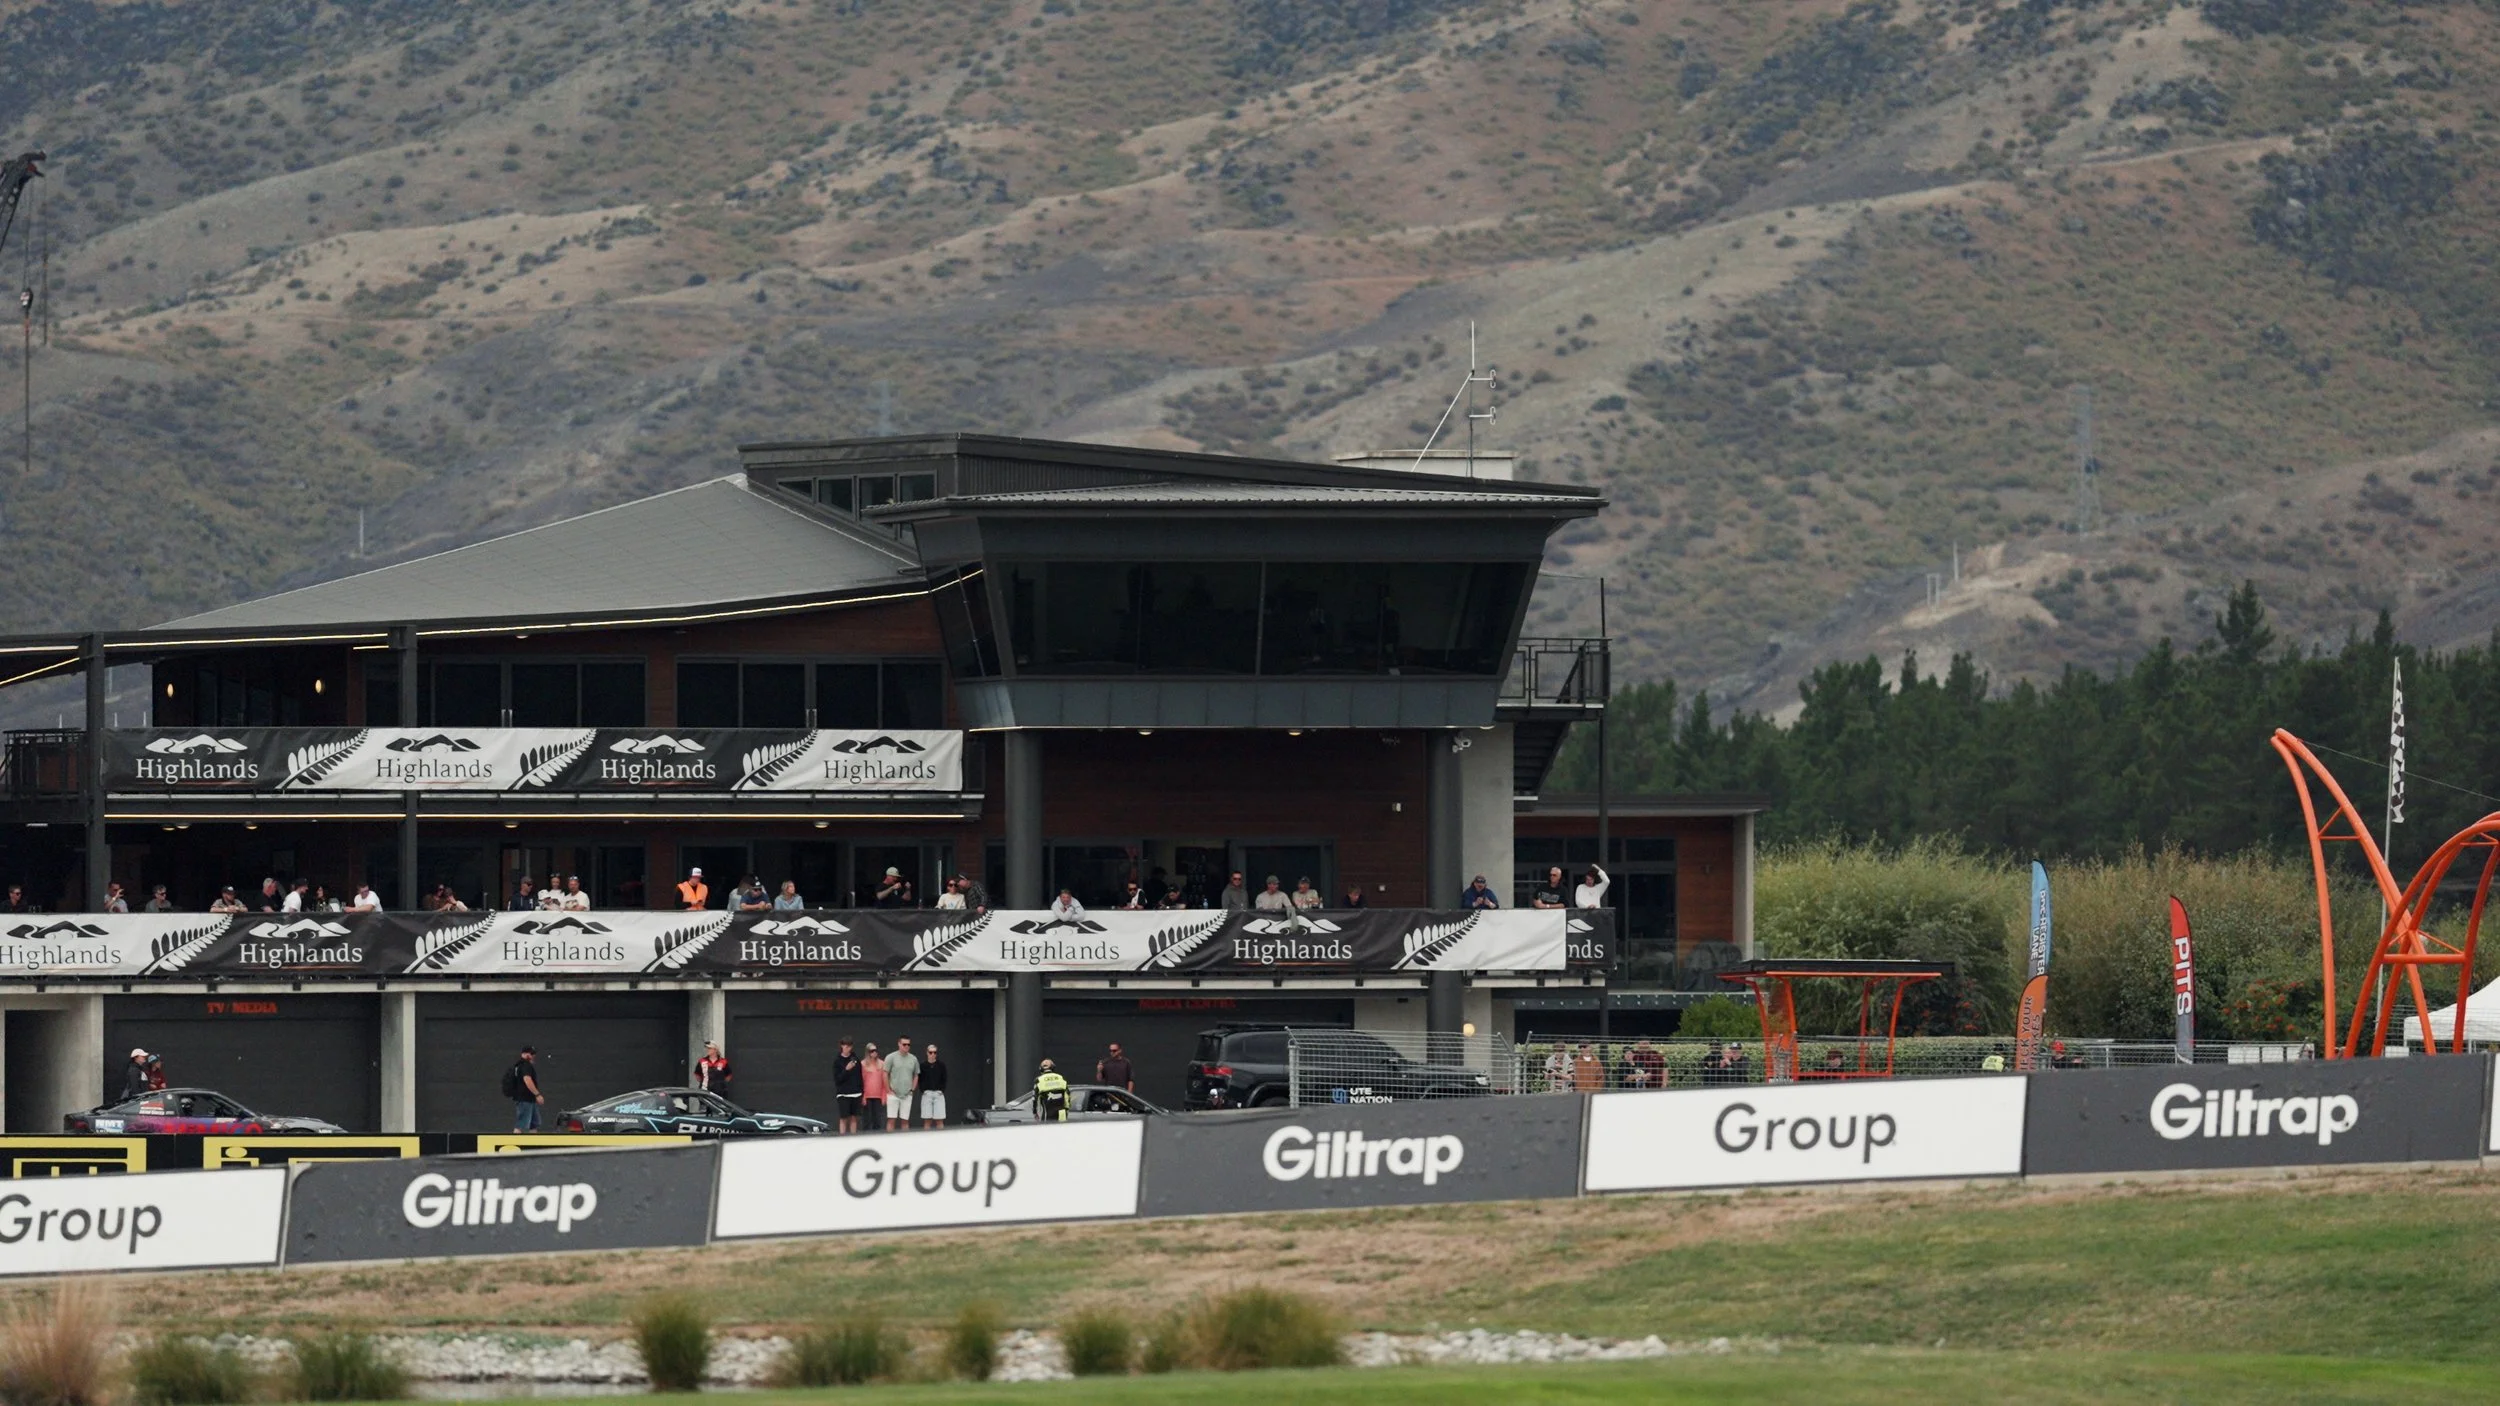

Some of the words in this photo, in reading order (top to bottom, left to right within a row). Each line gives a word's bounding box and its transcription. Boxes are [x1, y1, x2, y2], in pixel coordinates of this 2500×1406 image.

[135, 758, 259, 783] Highlands
[375, 758, 493, 783] Highlands
[600, 758, 716, 785] Highlands
[823, 759, 936, 785] Highlands
[0, 944, 122, 970] Highlands
[239, 942, 363, 967] Highlands
[503, 941, 625, 967] Highlands
[739, 940, 862, 967] Highlands
[1001, 940, 1120, 967] Highlands
[1232, 938, 1353, 965] Highlands
[2174, 936, 2192, 1016] PITS
[207, 1002, 225, 1013] TV
[232, 1002, 277, 1013] MEDIA
[2022, 996, 2033, 1032] YOUR
[1350, 1087, 1372, 1095] UTE
[1350, 1096, 1393, 1104] NATION
[2150, 1083, 2359, 1146] Giltrap
[1716, 1102, 1897, 1164] Group
[1263, 1125, 1464, 1186] Giltrap
[842, 1148, 1017, 1208] Group
[402, 1173, 597, 1233] Giltrap
[0, 1193, 162, 1255] Group
